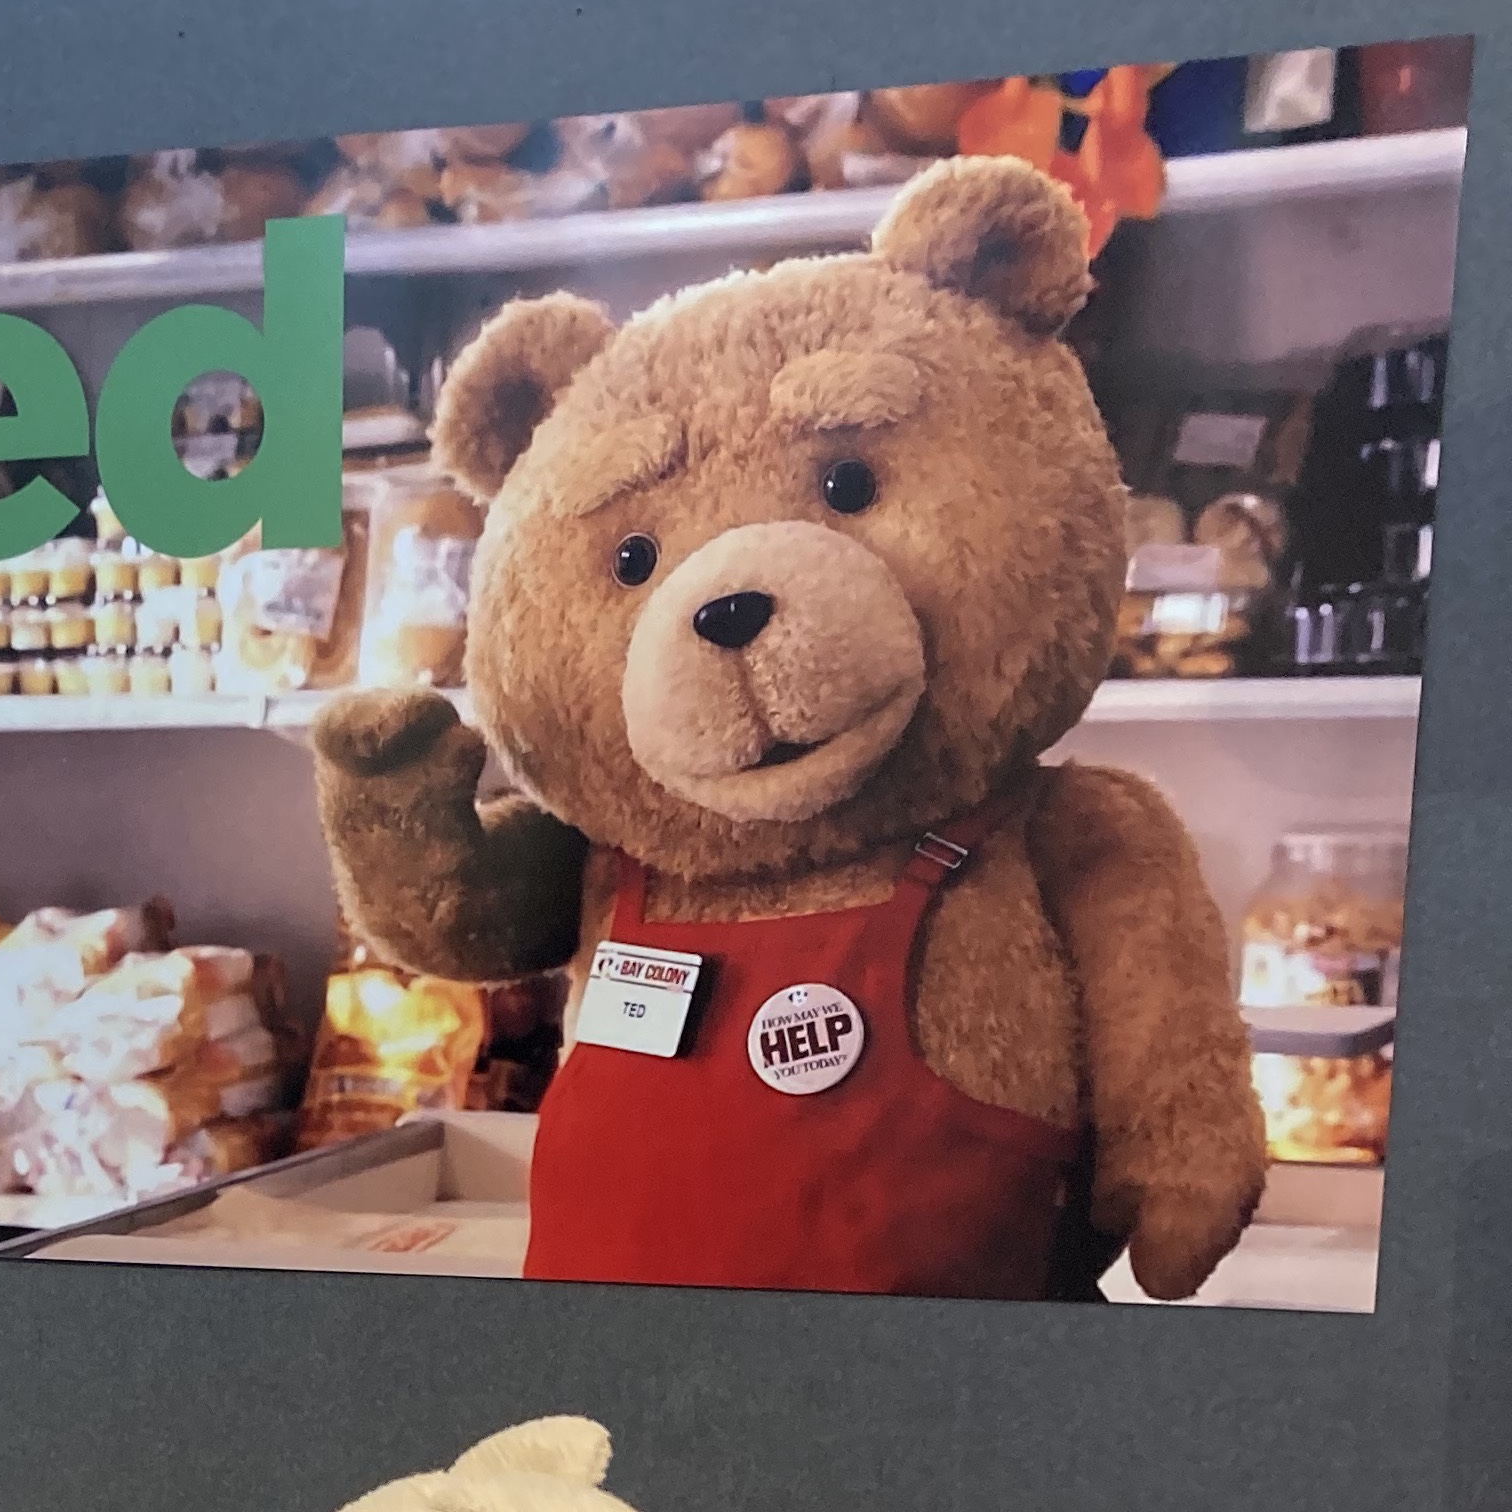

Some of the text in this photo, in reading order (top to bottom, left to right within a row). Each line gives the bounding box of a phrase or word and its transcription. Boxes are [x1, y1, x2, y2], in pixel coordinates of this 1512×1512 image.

[620, 960, 690, 986] BAY COLONY
[623, 1001, 646, 1019] TED
[794, 1006, 820, 1021] MAY
[821, 1001, 844, 1015] WE
[760, 1013, 852, 1069] HELP
[773, 1062, 801, 1080] YOU
